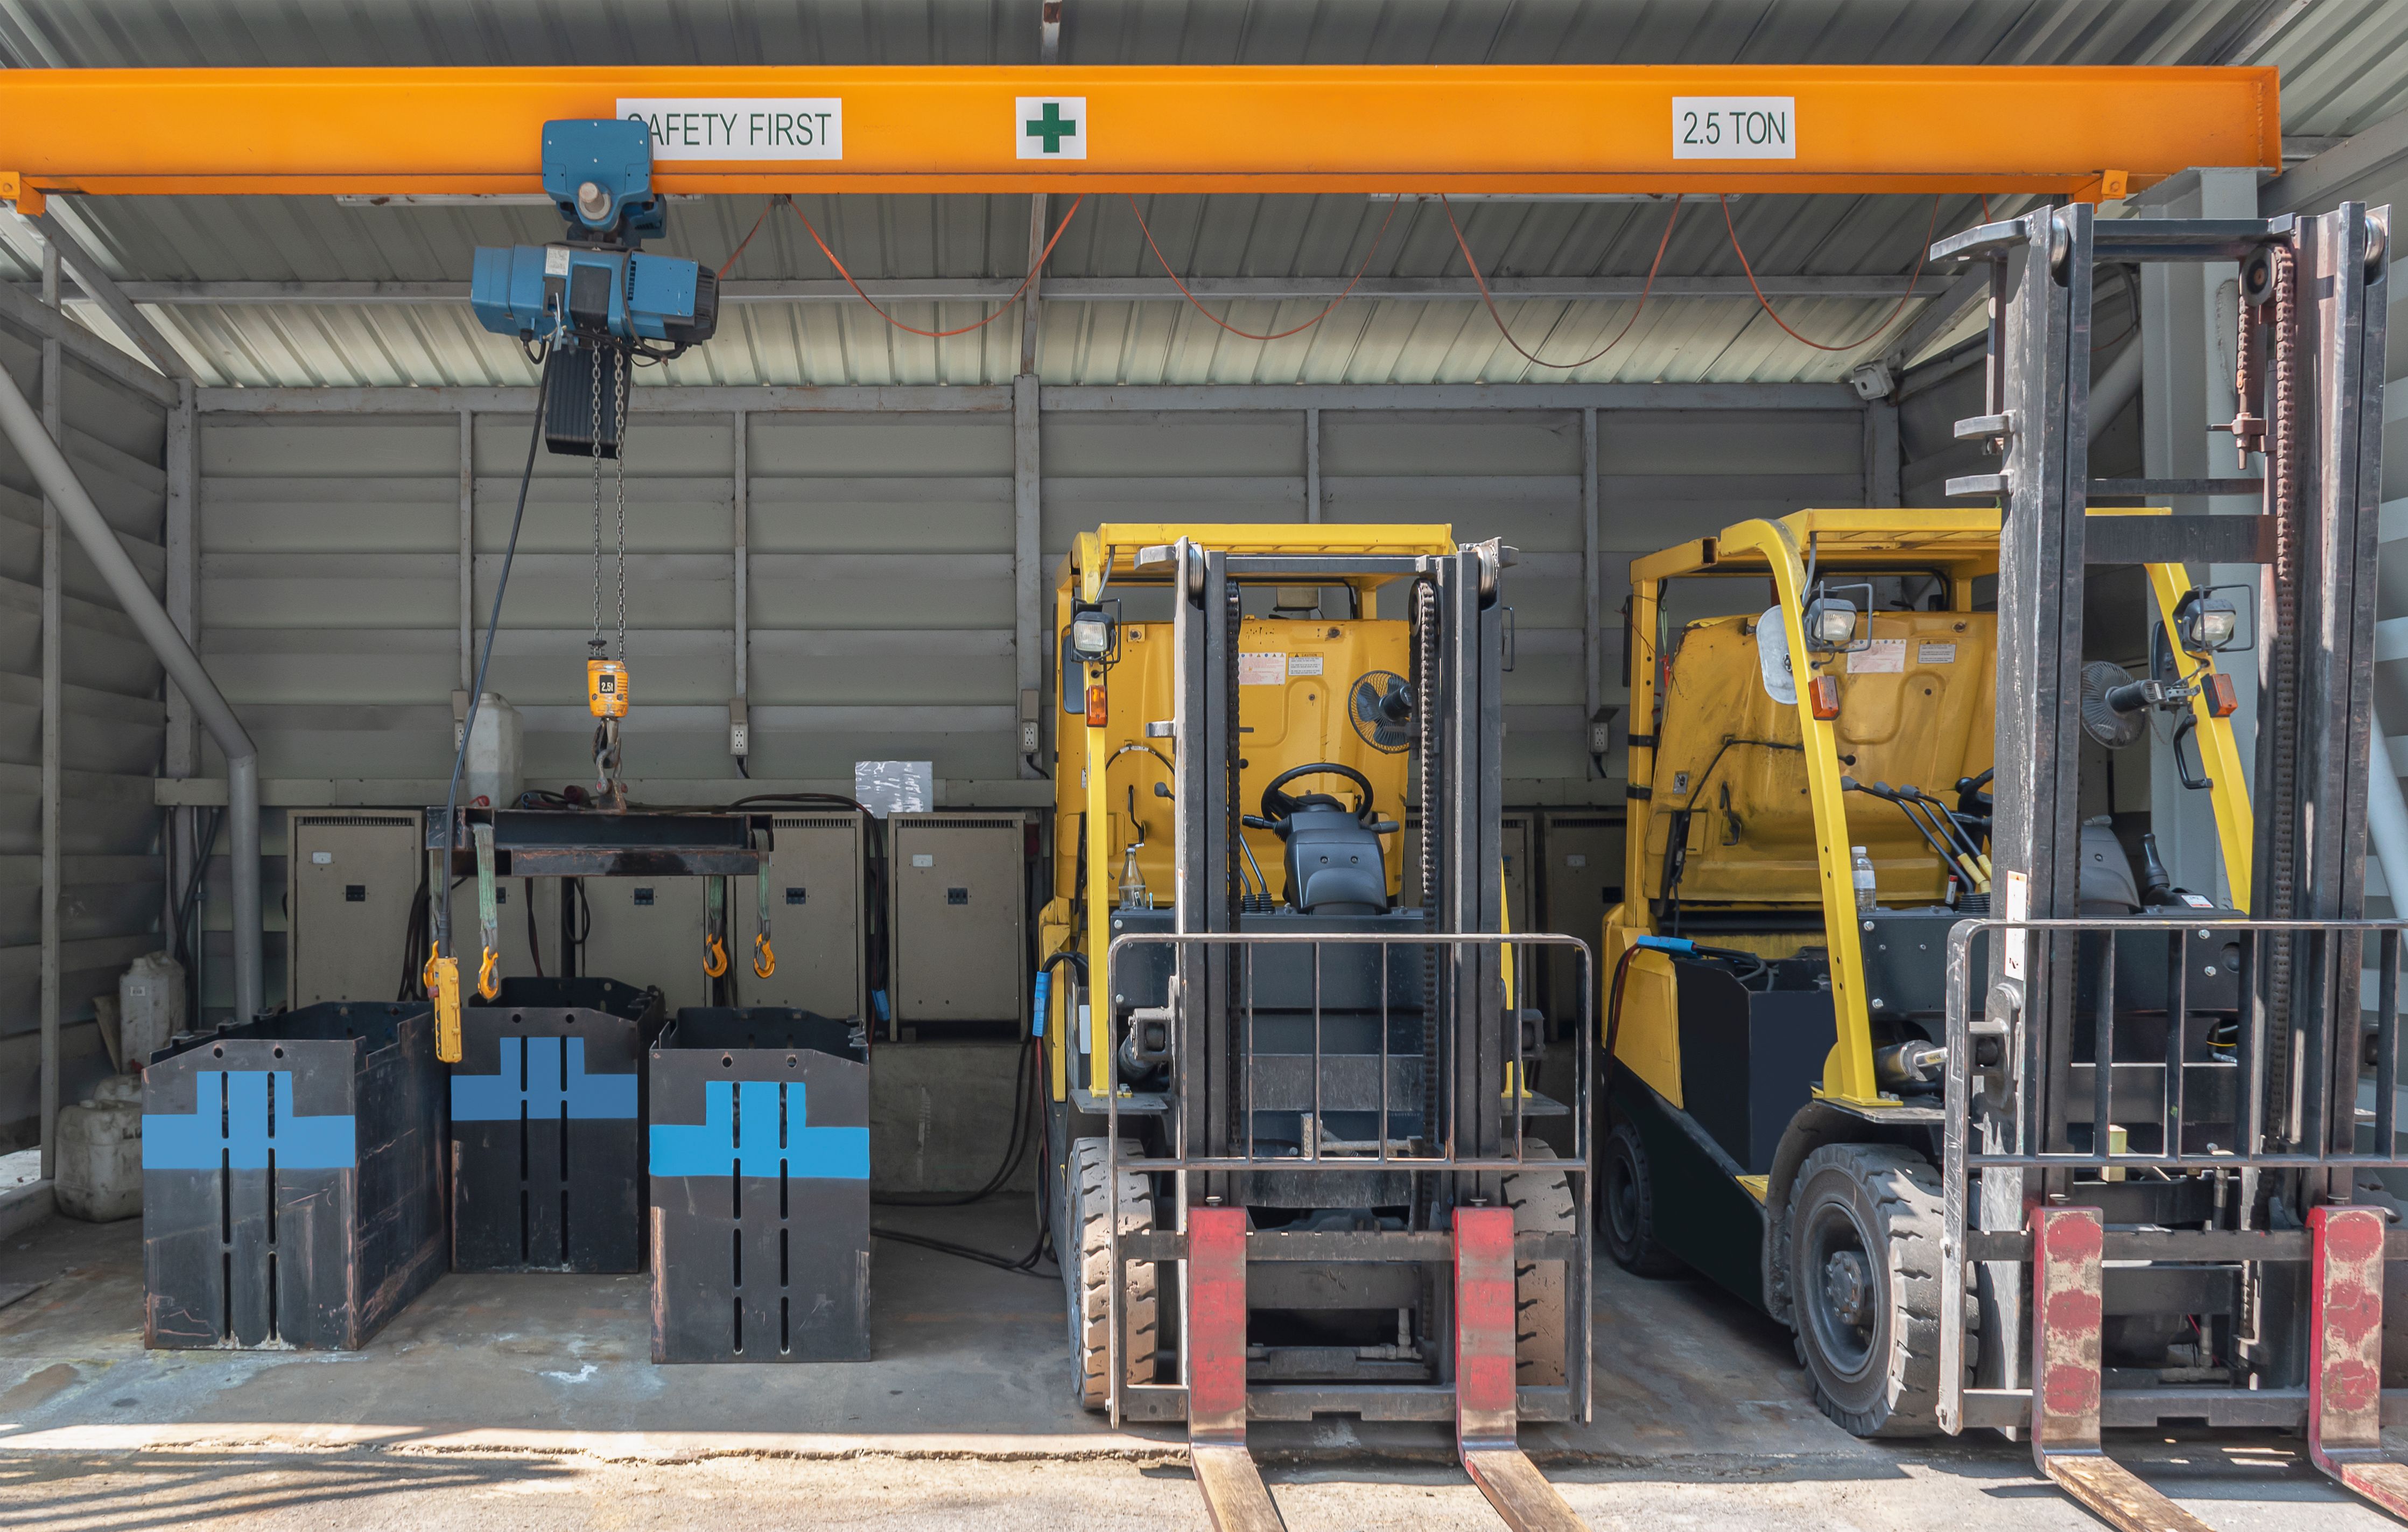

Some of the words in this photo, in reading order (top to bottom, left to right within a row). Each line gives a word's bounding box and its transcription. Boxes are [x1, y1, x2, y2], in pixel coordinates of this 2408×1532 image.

[627, 113, 738, 145] AFETY
[750, 113, 832, 146] FIRST
[1683, 111, 1720, 145] 2.5
[1729, 111, 1785, 145] TON
